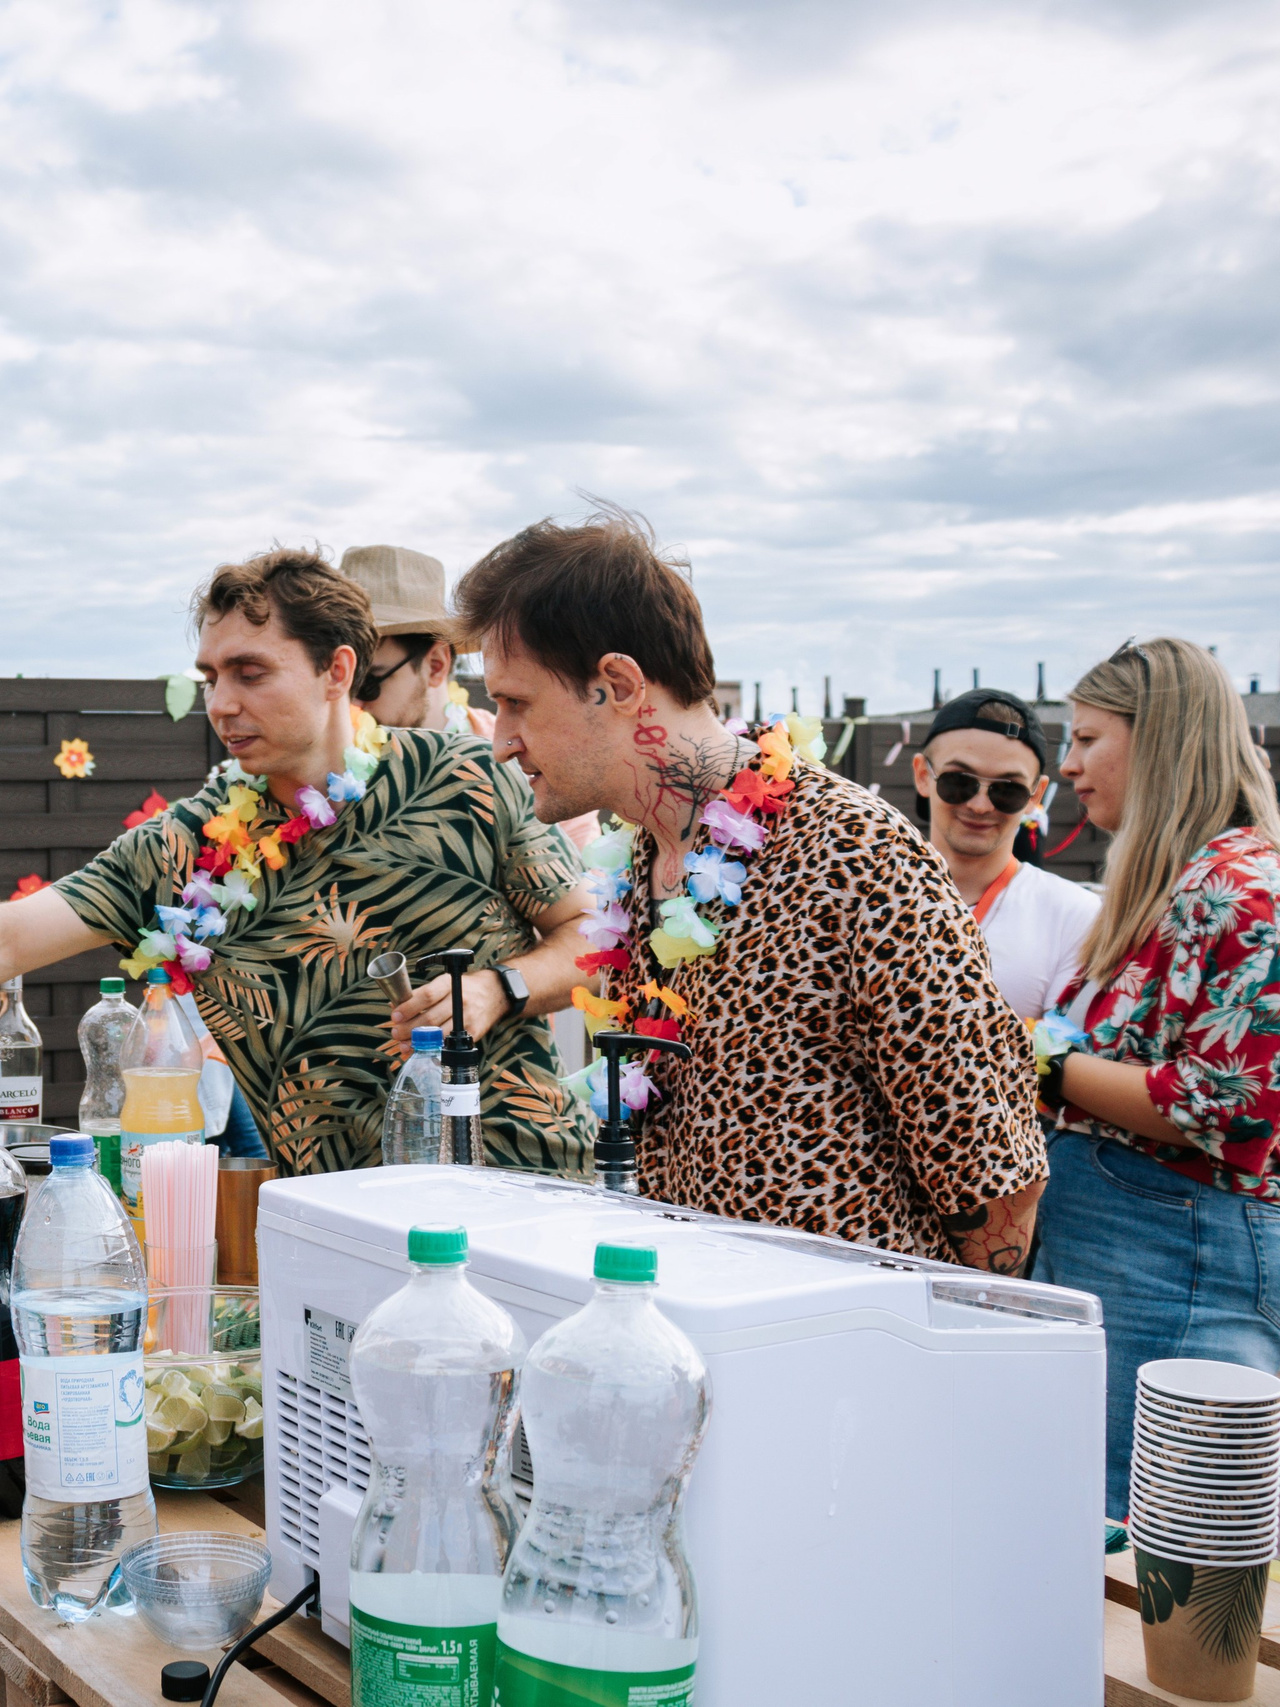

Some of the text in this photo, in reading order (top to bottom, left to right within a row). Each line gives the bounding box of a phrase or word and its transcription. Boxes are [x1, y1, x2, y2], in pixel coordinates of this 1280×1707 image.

[0, 1107, 34, 1115] BLANCO
[27, 1416, 50, 1431] Вода
[441, 1640, 456, 1655] 1,5
